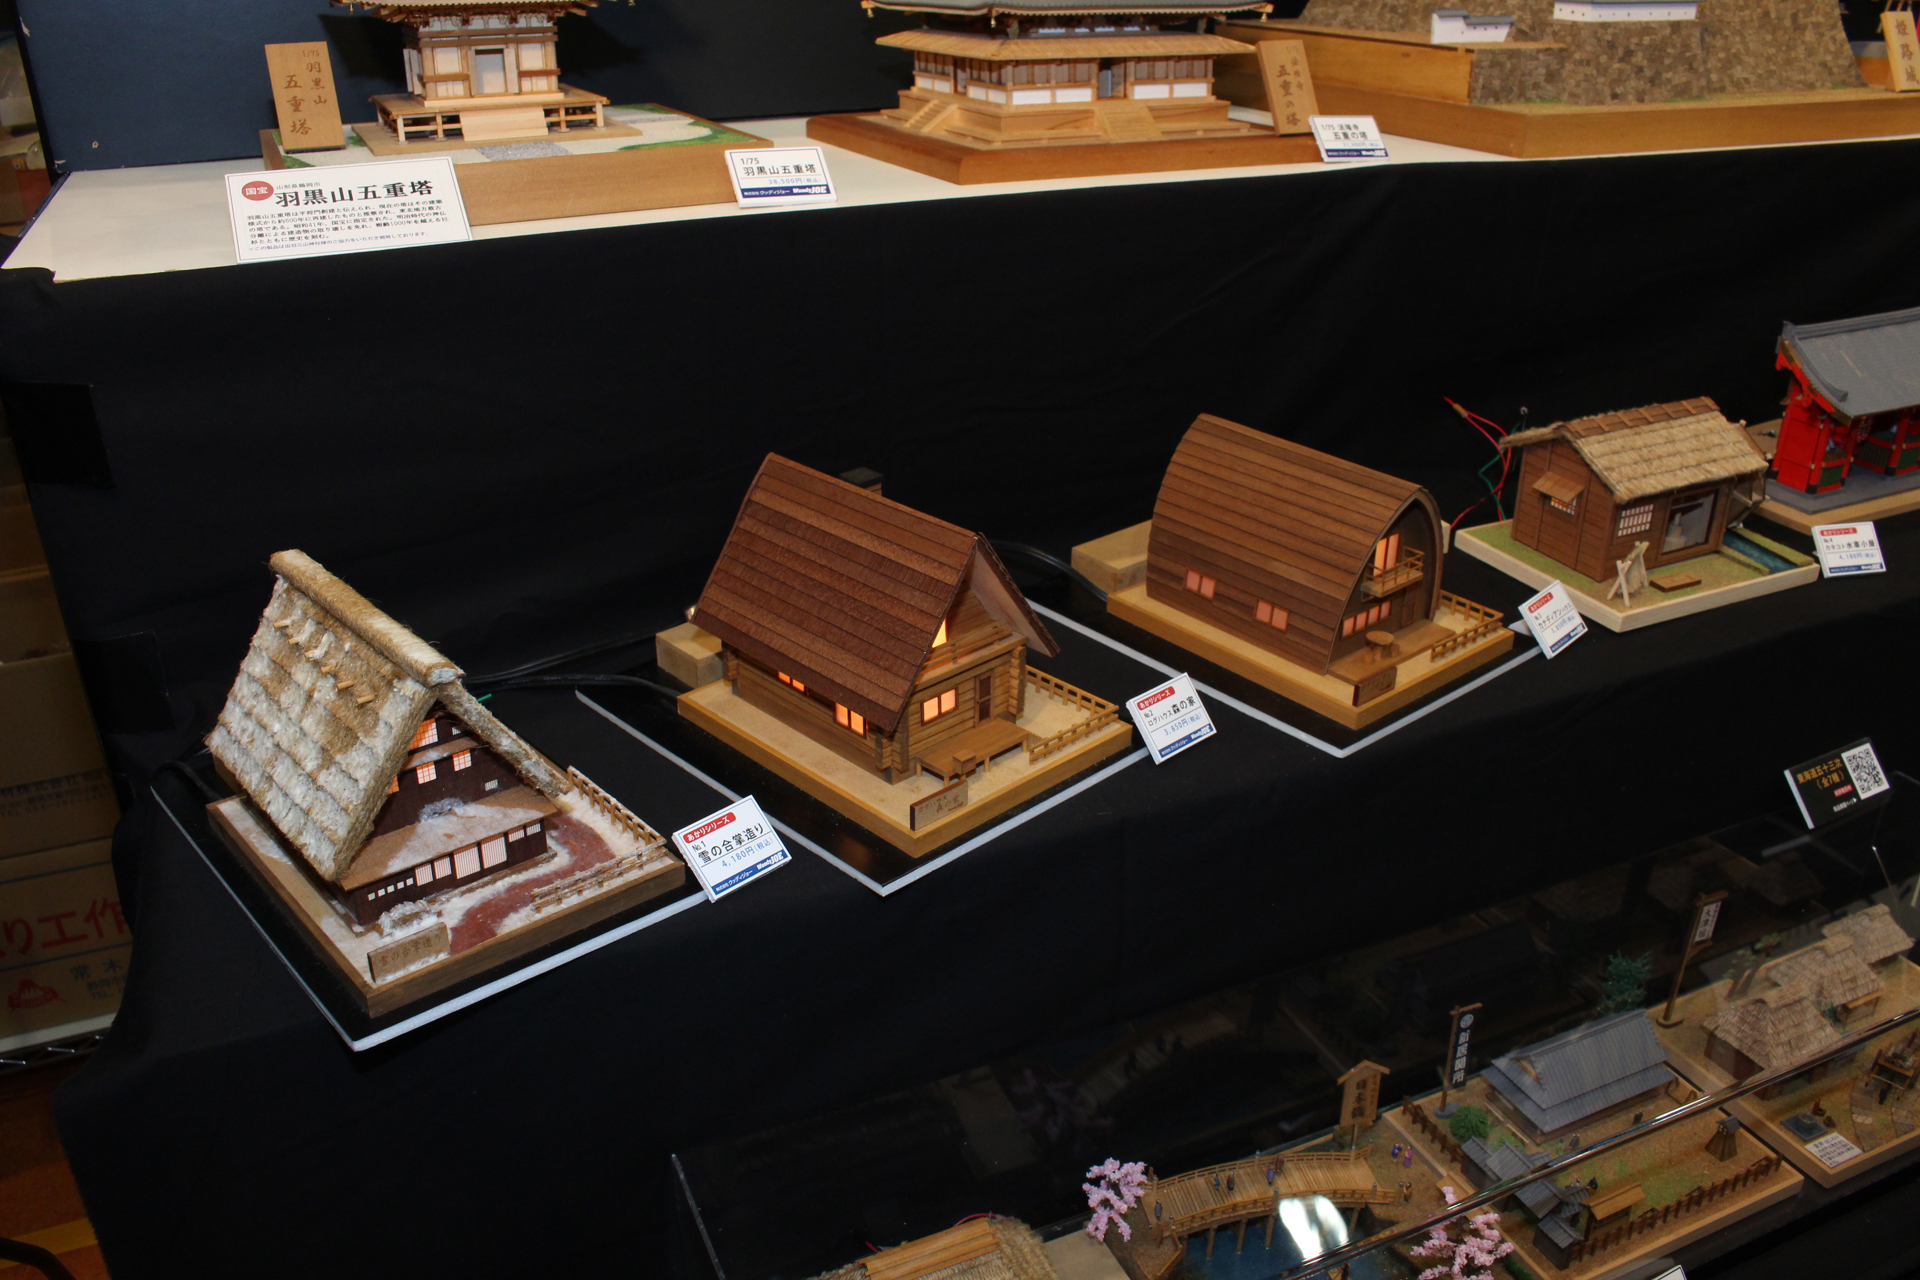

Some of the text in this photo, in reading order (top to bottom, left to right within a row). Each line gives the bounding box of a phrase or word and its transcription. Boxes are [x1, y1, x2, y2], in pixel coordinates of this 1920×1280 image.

[1895, 19, 1920, 85] 姫路城
[306, 61, 327, 104] 羽黒山
[1277, 64, 1301, 126] 五重の塔
[284, 74, 312, 135] 五重塔
[1333, 131, 1369, 140] 五重の塔
[744, 164, 816, 176] 羽黒山五重塔
[245, 186, 269, 196] 国宝
[275, 180, 433, 207] 羽黒山五重塔
[1139, 690, 1171, 709] あかりシリーズ
[687, 816, 730, 841] あかりシリーズ
[698, 822, 764, 864] 雪の合掌造り
[721, 837, 774, 868] 4,180円(税込)
[0, 897, 130, 957] り工作
